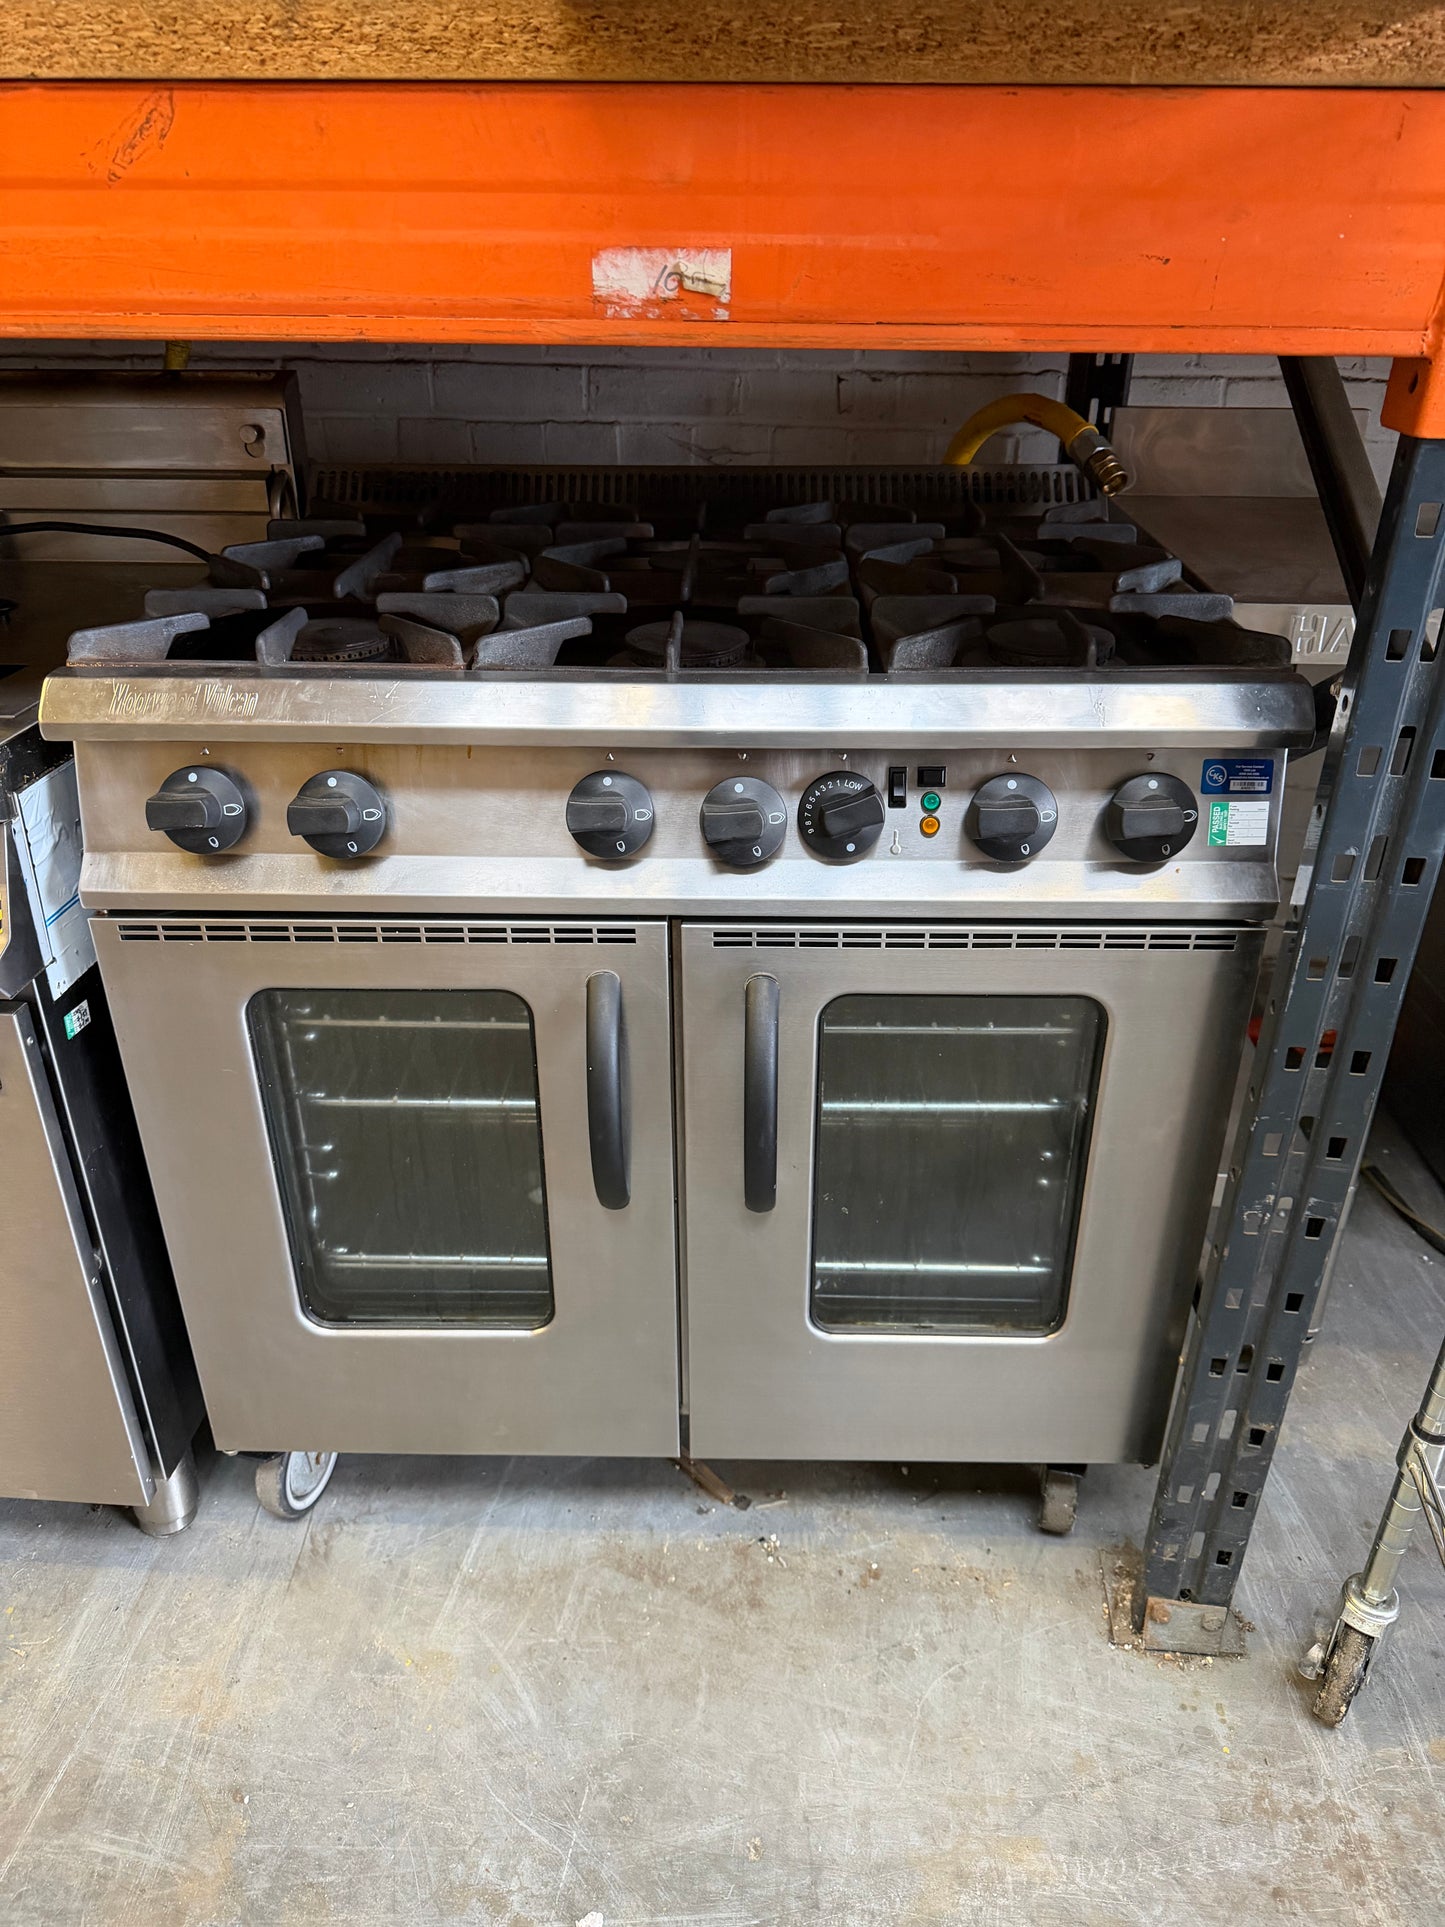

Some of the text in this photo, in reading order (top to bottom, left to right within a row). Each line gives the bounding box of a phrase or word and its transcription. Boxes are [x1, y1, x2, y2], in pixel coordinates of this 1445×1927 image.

[204, 683, 259, 717] Vulcan
[844, 779, 863, 791] LOW
[1209, 769, 1223, 782] CKS
[1212, 806, 1221, 833] PASSED
